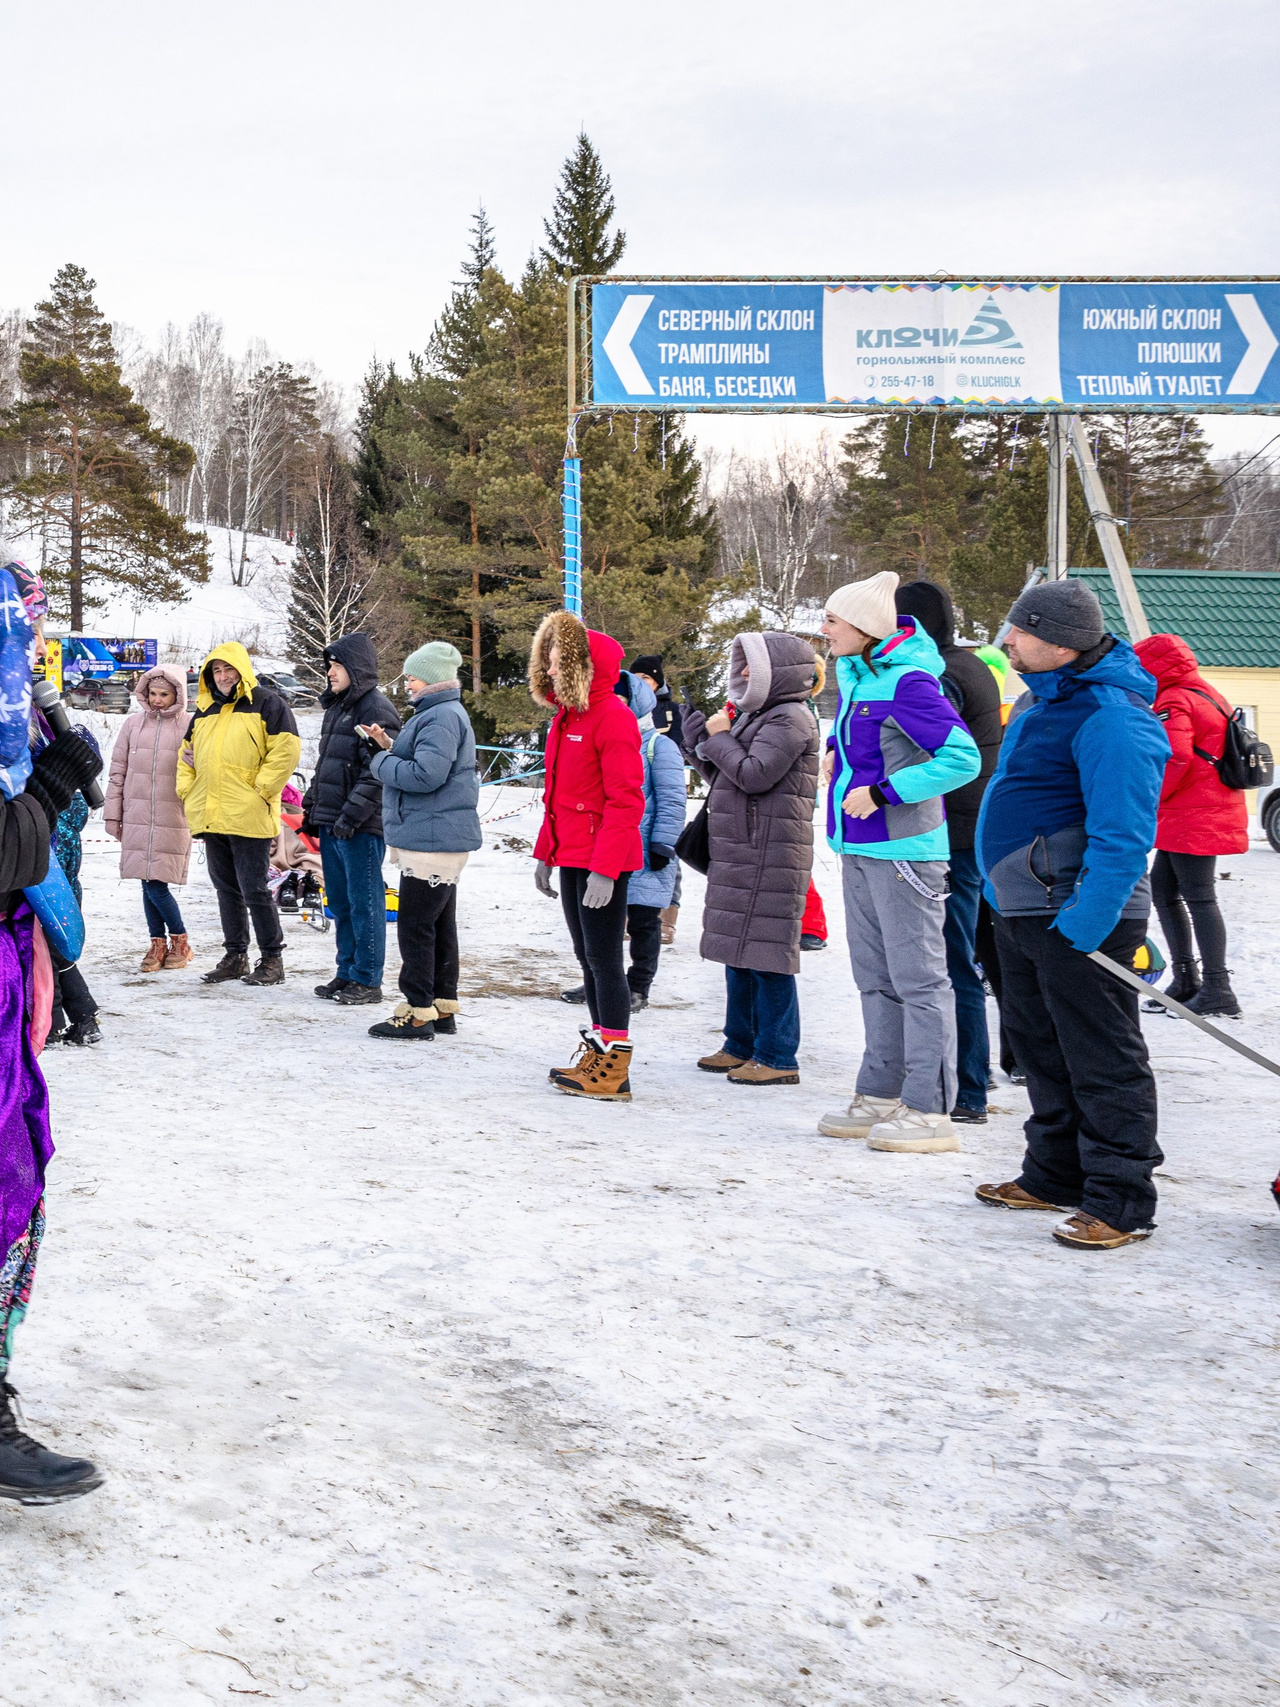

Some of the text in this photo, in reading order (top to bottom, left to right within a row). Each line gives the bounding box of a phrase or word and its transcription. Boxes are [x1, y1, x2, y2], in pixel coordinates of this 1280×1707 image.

[658, 305, 815, 331] СЕВЕРНЫЙ СКЛОН
[1083, 304, 1222, 330] ЮЖНЫЙ СКЛОН
[657, 343, 770, 364] ТРАМПЛИНЫ
[856, 352, 1026, 367] горнолыжный комплекс
[1138, 342, 1222, 363] ПЛЮШКИ
[658, 376, 797, 399] БАНЯ, БЕСЕДКИ
[881, 375, 935, 387] 255-47-18
[971, 376, 1022, 388] KLUCHIGLK
[1076, 371, 1223, 396] ТЕПЛЫЙ ТУАЛЕТ
